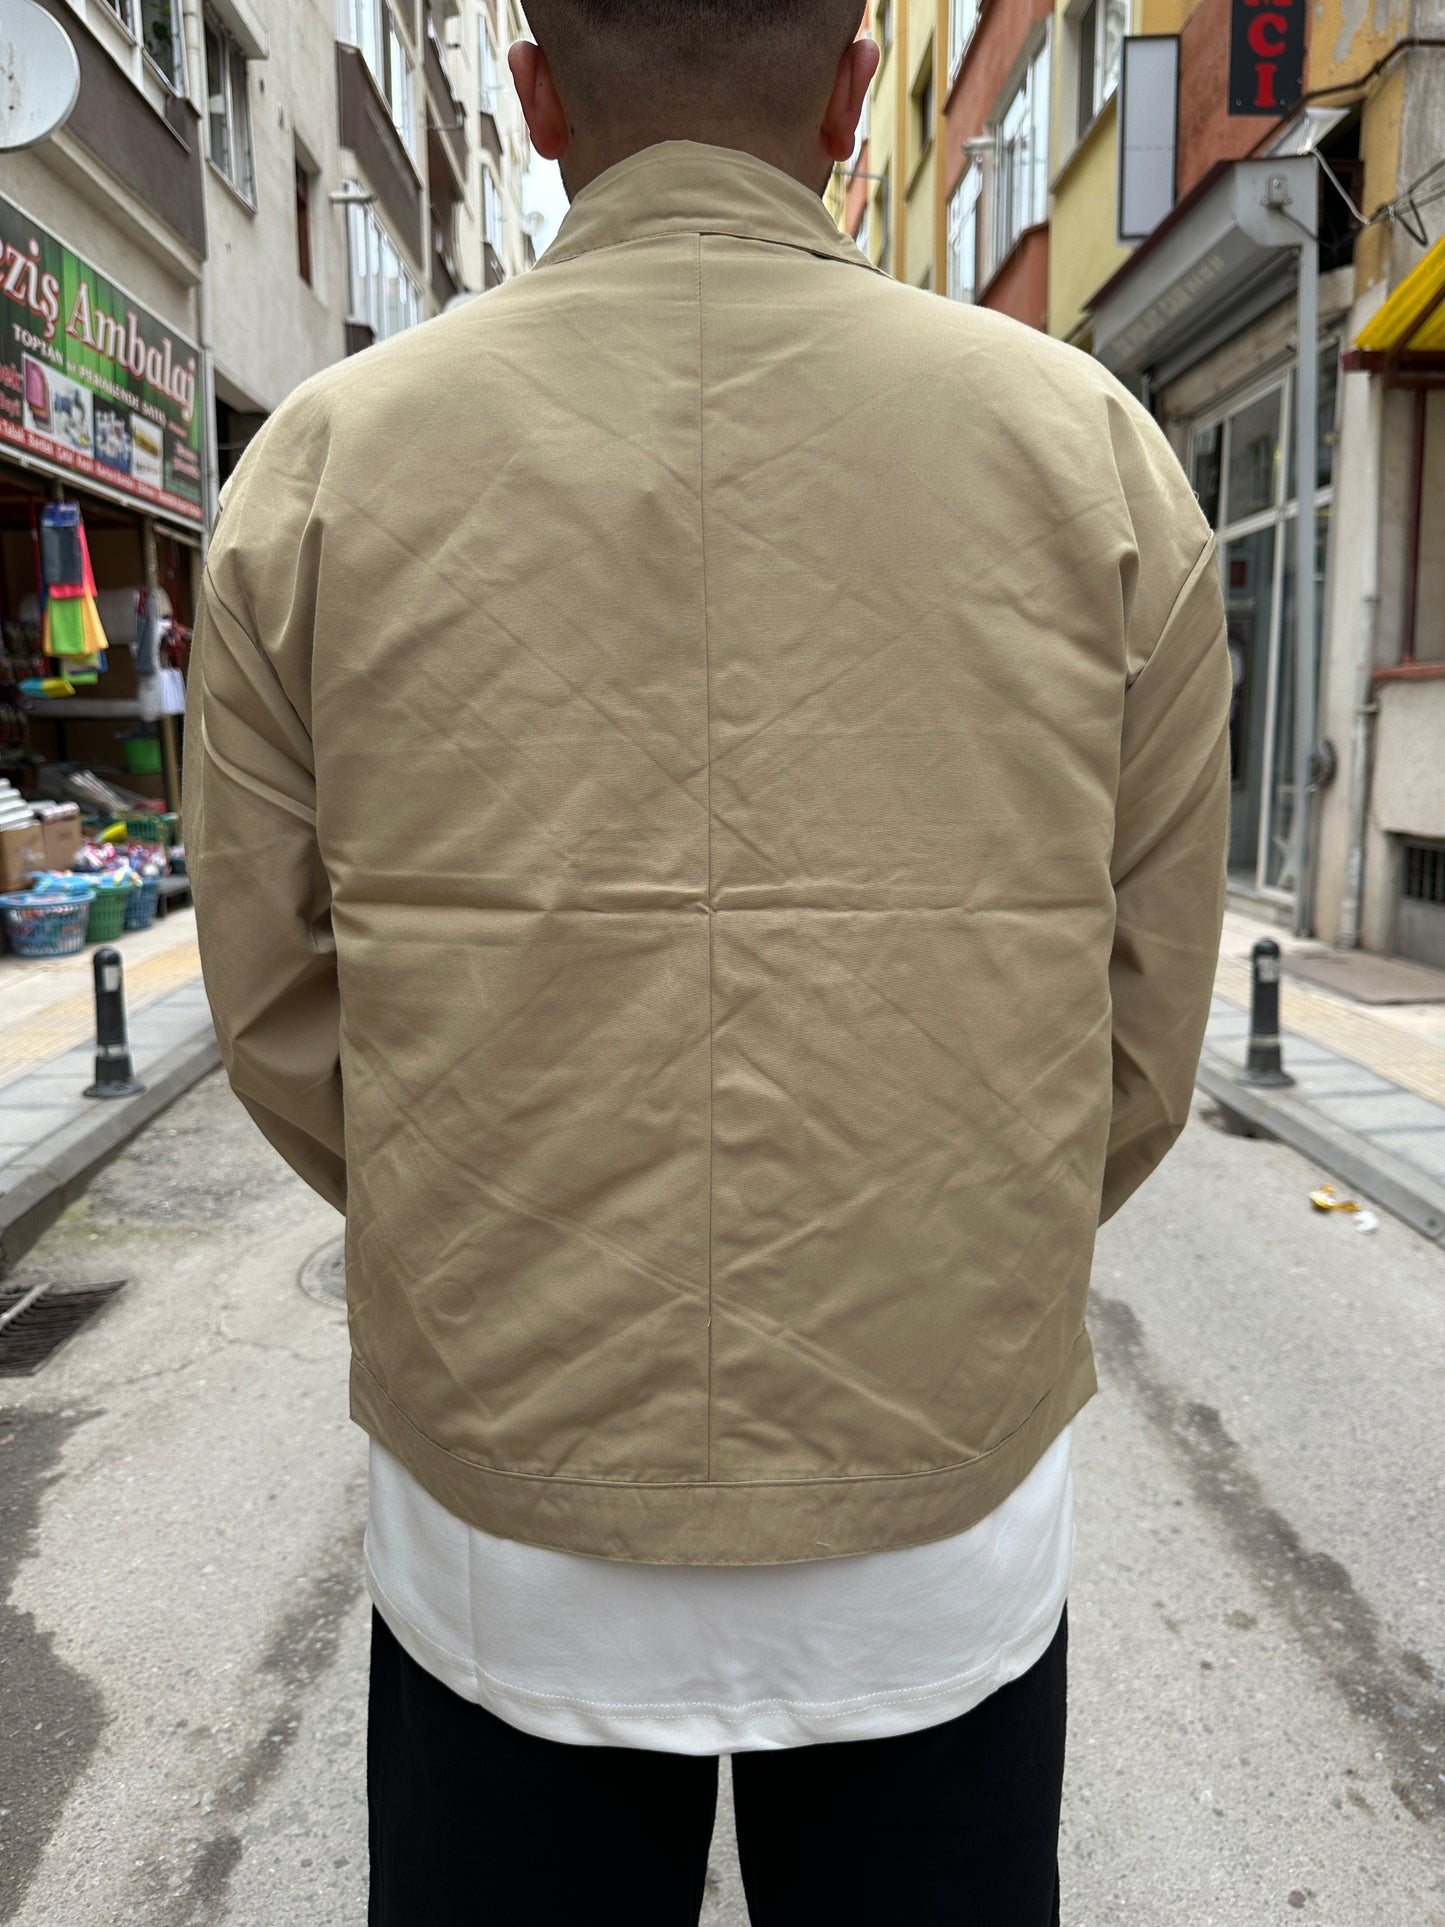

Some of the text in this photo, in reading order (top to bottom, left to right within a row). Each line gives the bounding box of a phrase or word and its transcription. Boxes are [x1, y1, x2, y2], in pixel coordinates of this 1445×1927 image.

[1244, 0, 1292, 107] CI
[12, 322, 64, 366] TOPTAN
[66, 280, 195, 422] Ambalaj
